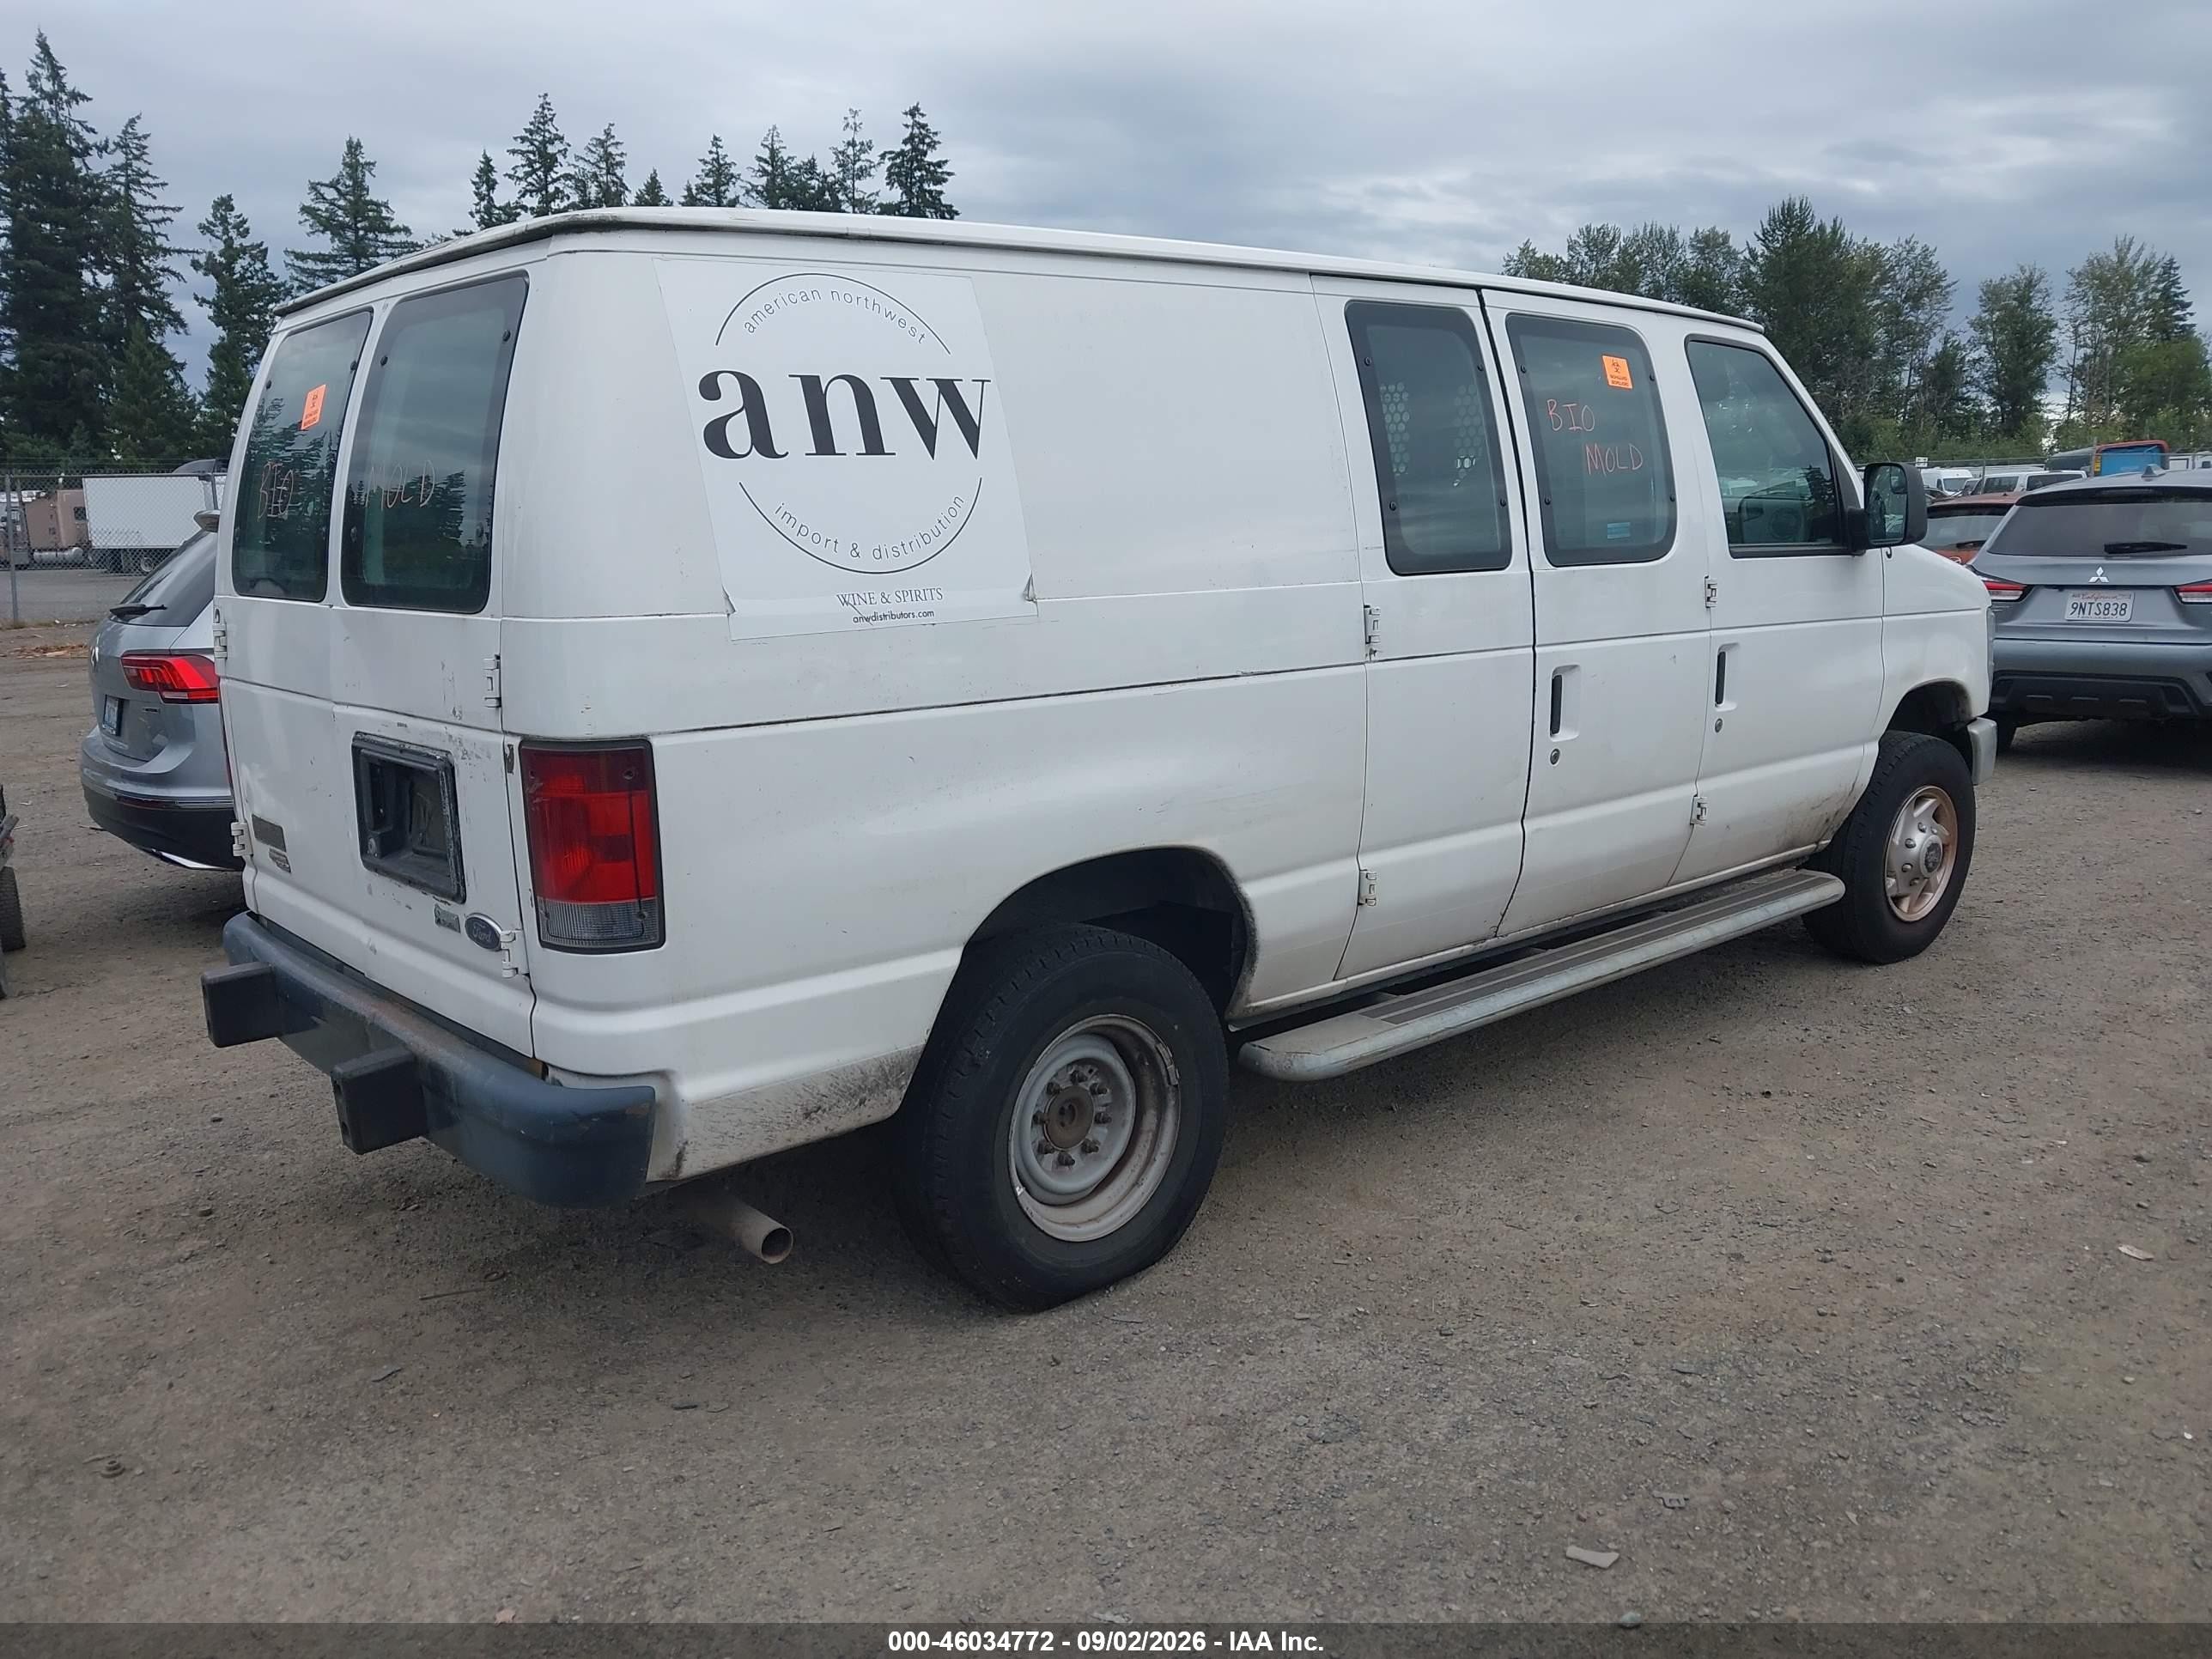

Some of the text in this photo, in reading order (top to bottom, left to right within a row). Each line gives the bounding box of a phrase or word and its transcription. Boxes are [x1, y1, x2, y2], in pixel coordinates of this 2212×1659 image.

[744, 289, 926, 343] american northwest
[698, 370, 992, 460] anw
[1547, 399, 1595, 431] BIO
[1585, 443, 1644, 477] MOLD
[258, 459, 294, 520] BIO
[365, 460, 436, 510] MOLD
[775, 495, 964, 561] import & distribution
[836, 587, 944, 606] WINE & SPIRITS
[853, 609, 934, 624] anwdistributors.com
[2069, 602, 2128, 616] 9NTS838
